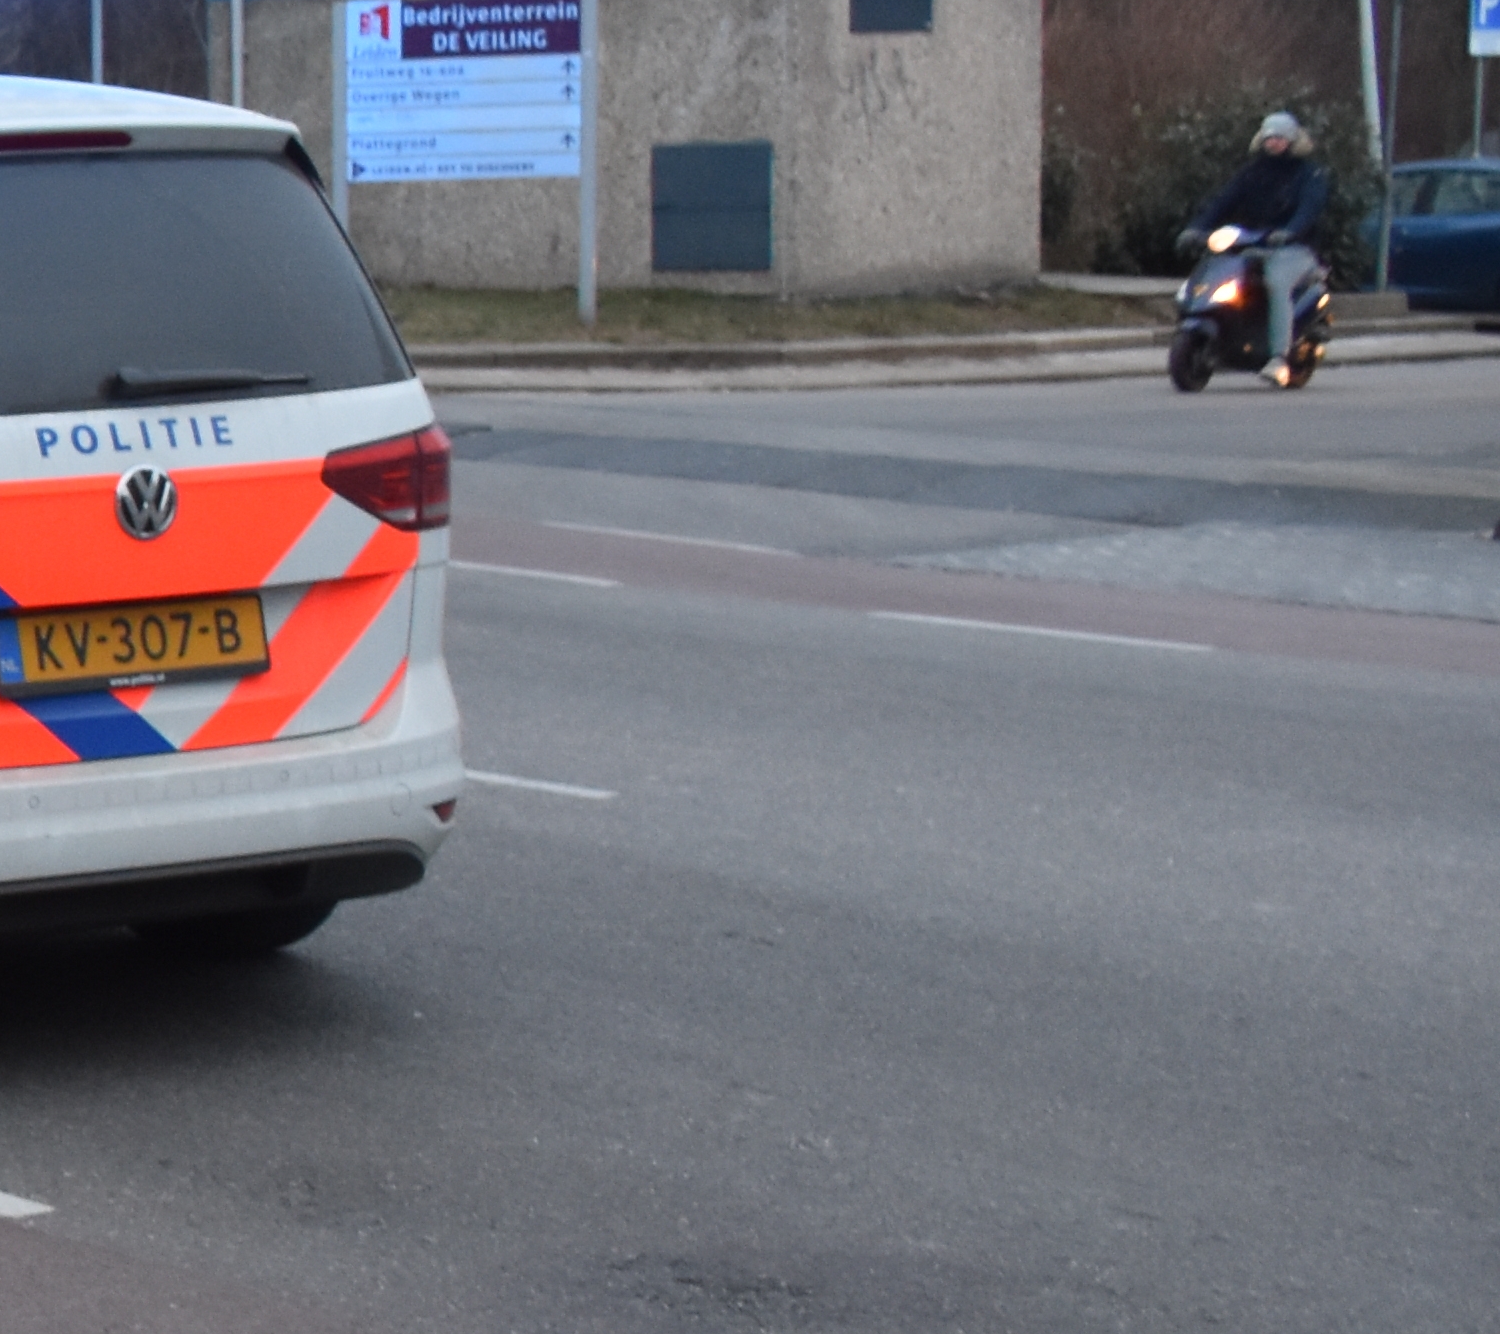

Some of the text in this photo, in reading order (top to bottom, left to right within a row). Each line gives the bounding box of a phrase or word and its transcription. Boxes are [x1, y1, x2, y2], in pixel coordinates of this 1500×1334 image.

[402, 0, 579, 29] Bedrijventerrein
[432, 28, 548, 52] DE VEILING
[352, 89, 460, 104] Overige Wegen
[352, 137, 437, 153] Plattegrond
[35, 415, 233, 458] POLITIE
[33, 608, 243, 672] KV-307-B
